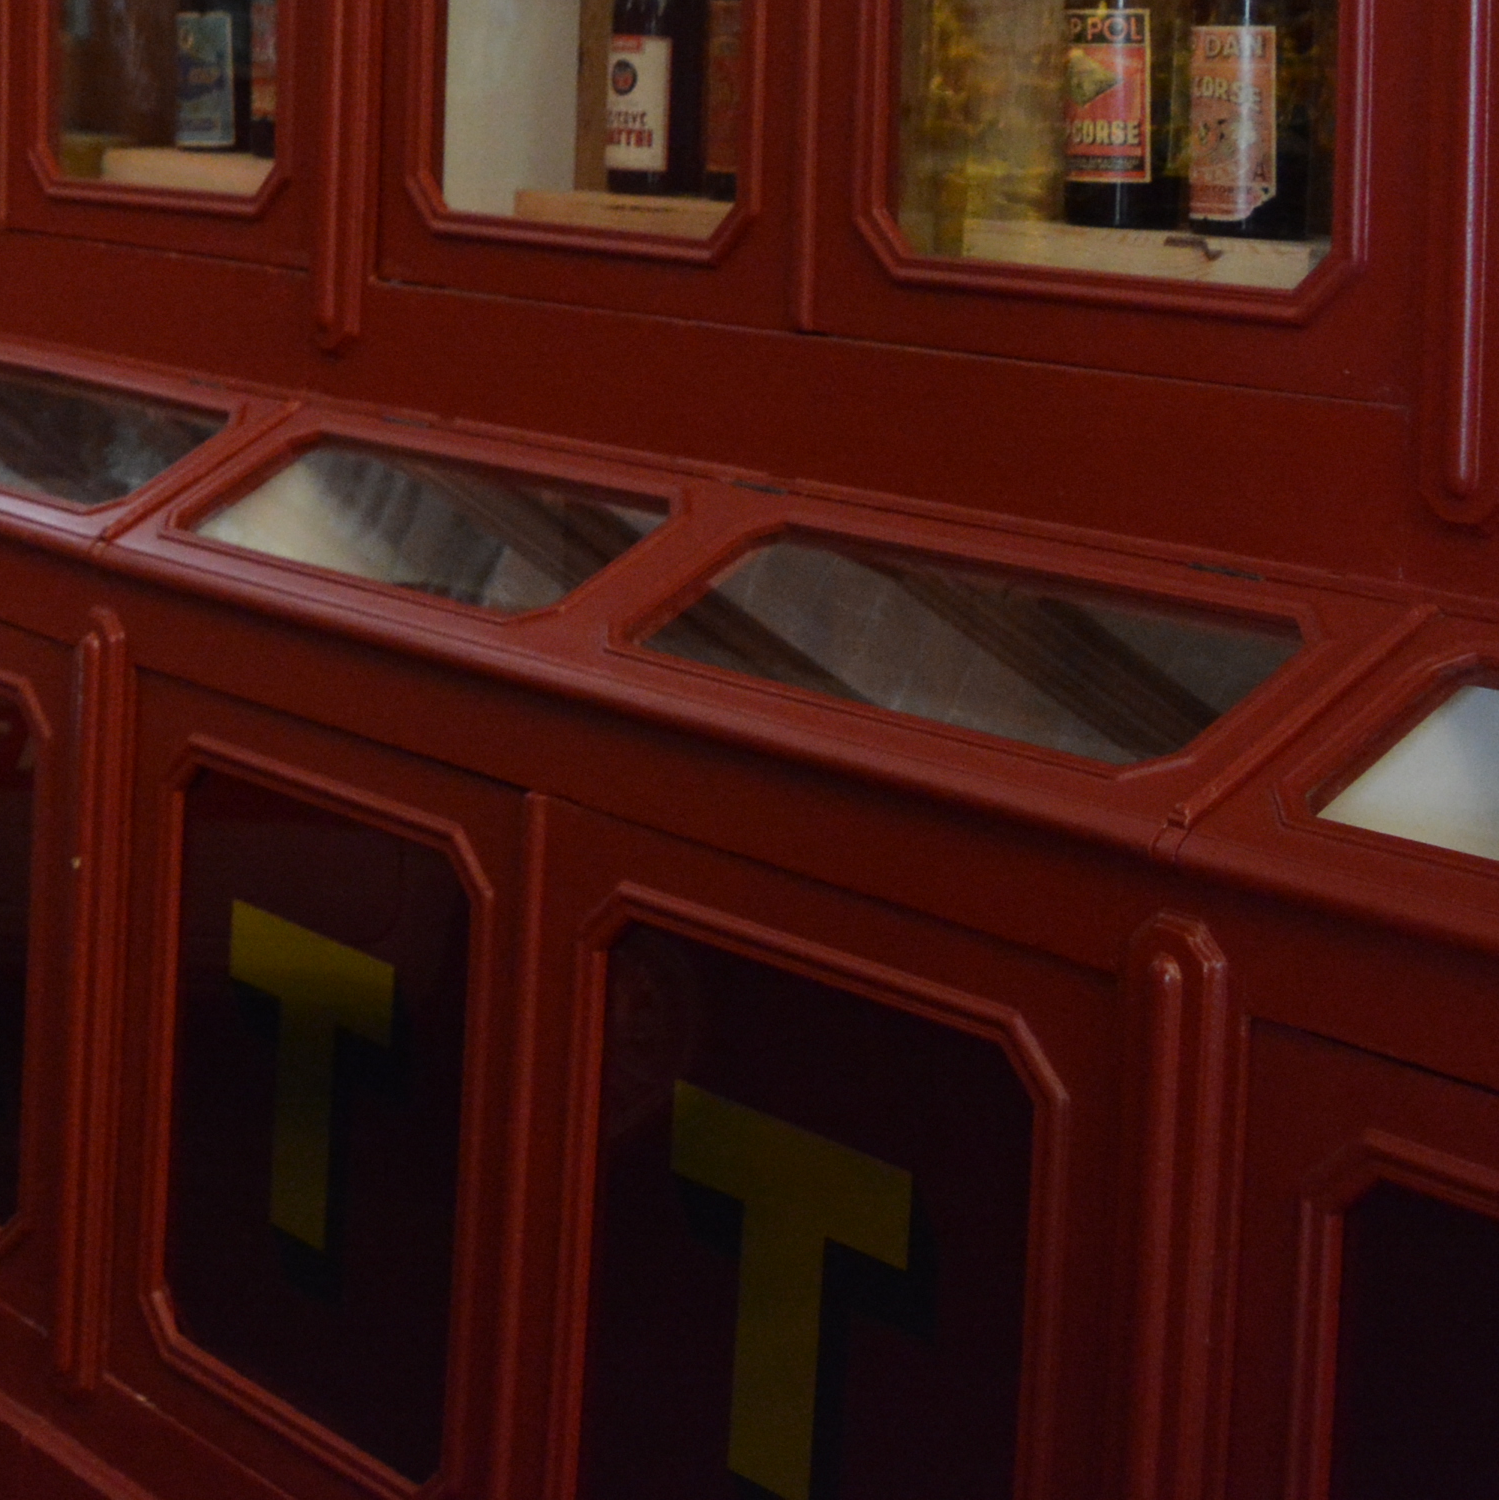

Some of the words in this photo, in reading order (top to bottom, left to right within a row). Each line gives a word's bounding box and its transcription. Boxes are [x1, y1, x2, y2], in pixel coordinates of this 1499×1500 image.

[1087, 16, 1143, 42] POL
[1072, 118, 1141, 146] CORSE
[229, 899, 396, 1254] T
[669, 1078, 914, 1500] T
